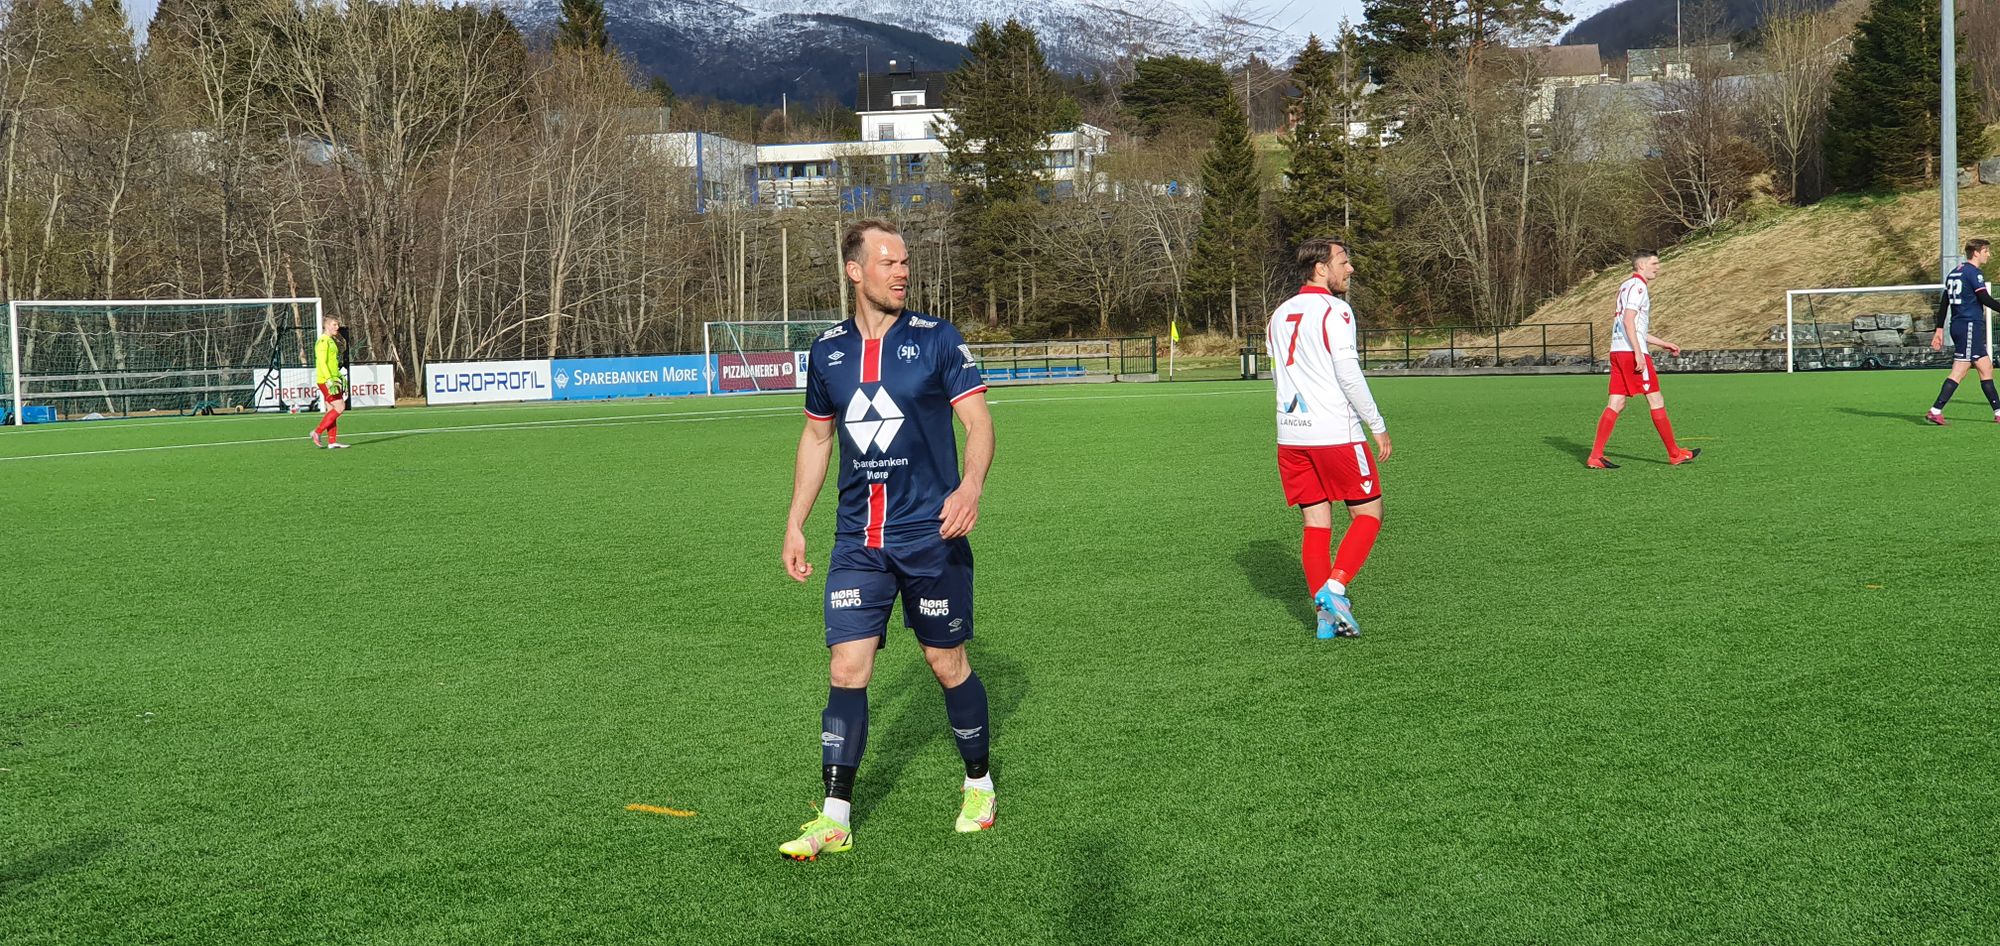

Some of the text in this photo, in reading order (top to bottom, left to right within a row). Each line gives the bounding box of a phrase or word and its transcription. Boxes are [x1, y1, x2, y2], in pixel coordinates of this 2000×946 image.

[1946, 278, 1963, 305] 22
[1285, 313, 1304, 367] 7
[434, 371, 545, 393] EUROPROFIL
[831, 589, 860, 600] MØRE
[831, 598, 862, 608] TRAFO
[920, 598, 949, 608] MØRE
[919, 605, 950, 616] TRAFO
